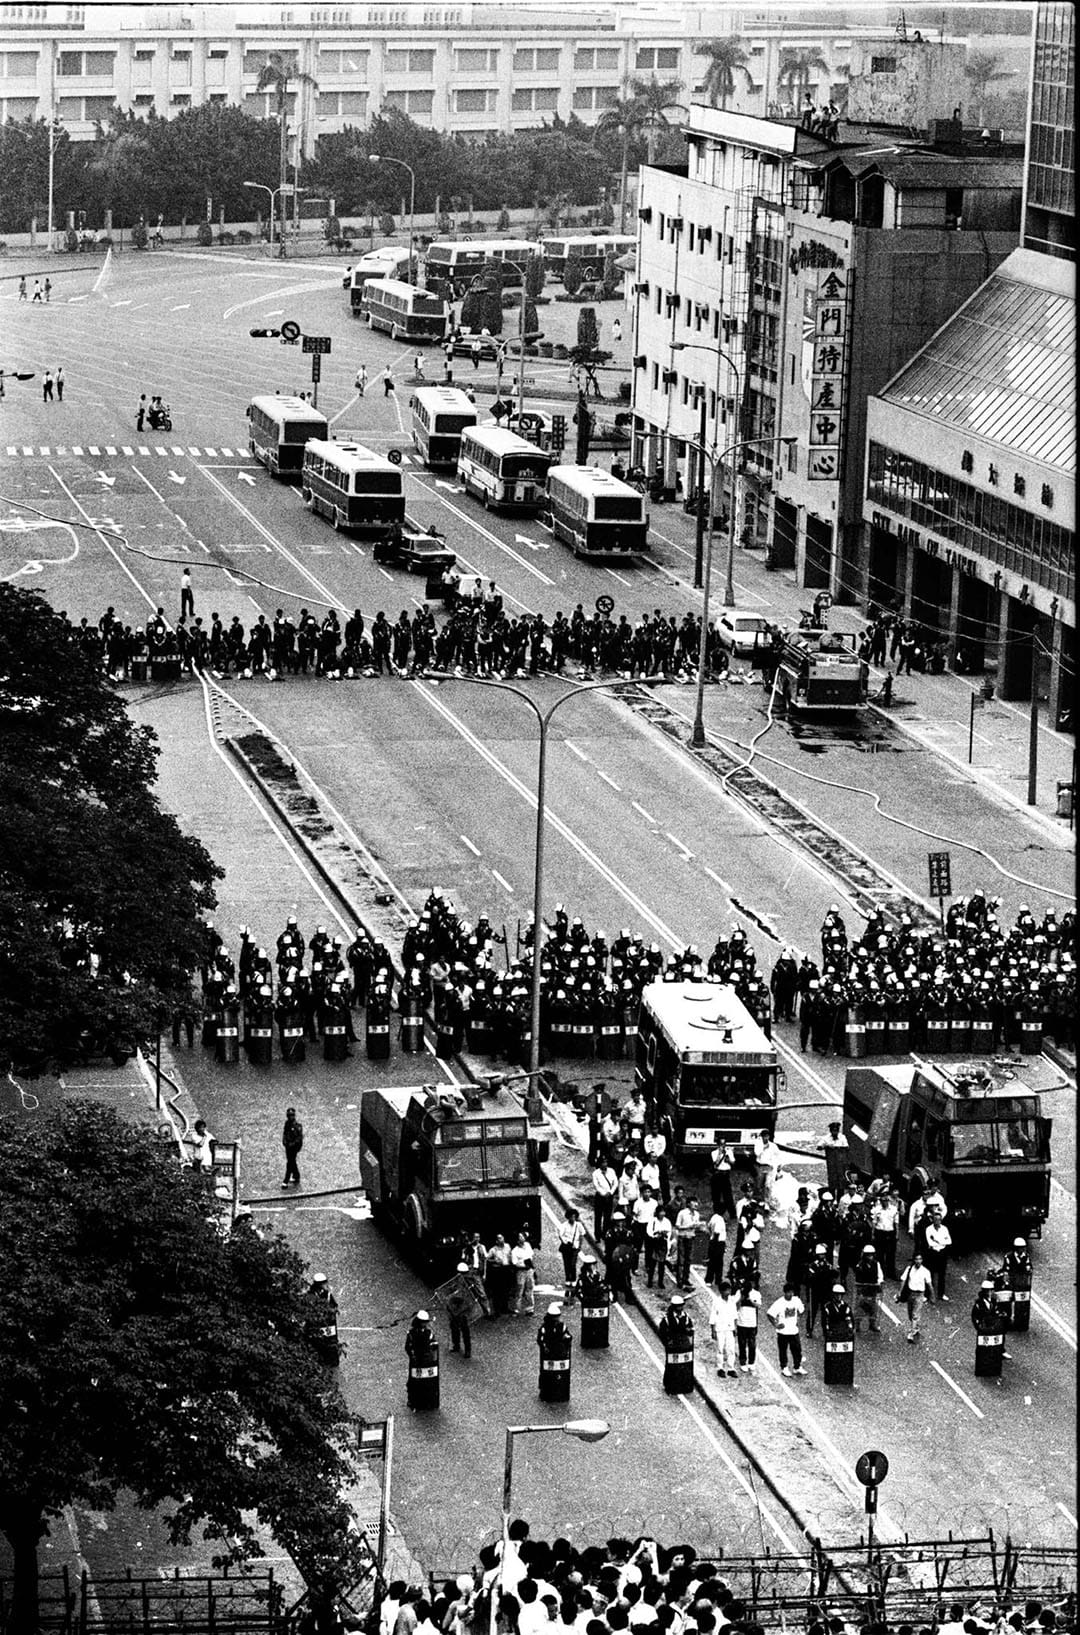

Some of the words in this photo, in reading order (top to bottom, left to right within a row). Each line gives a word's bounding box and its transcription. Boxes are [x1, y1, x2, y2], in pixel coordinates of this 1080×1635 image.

[813, 271, 846, 474] 金門特產中心
[926, 537, 939, 557] OF
[945, 547, 977, 576] TAIPEI
